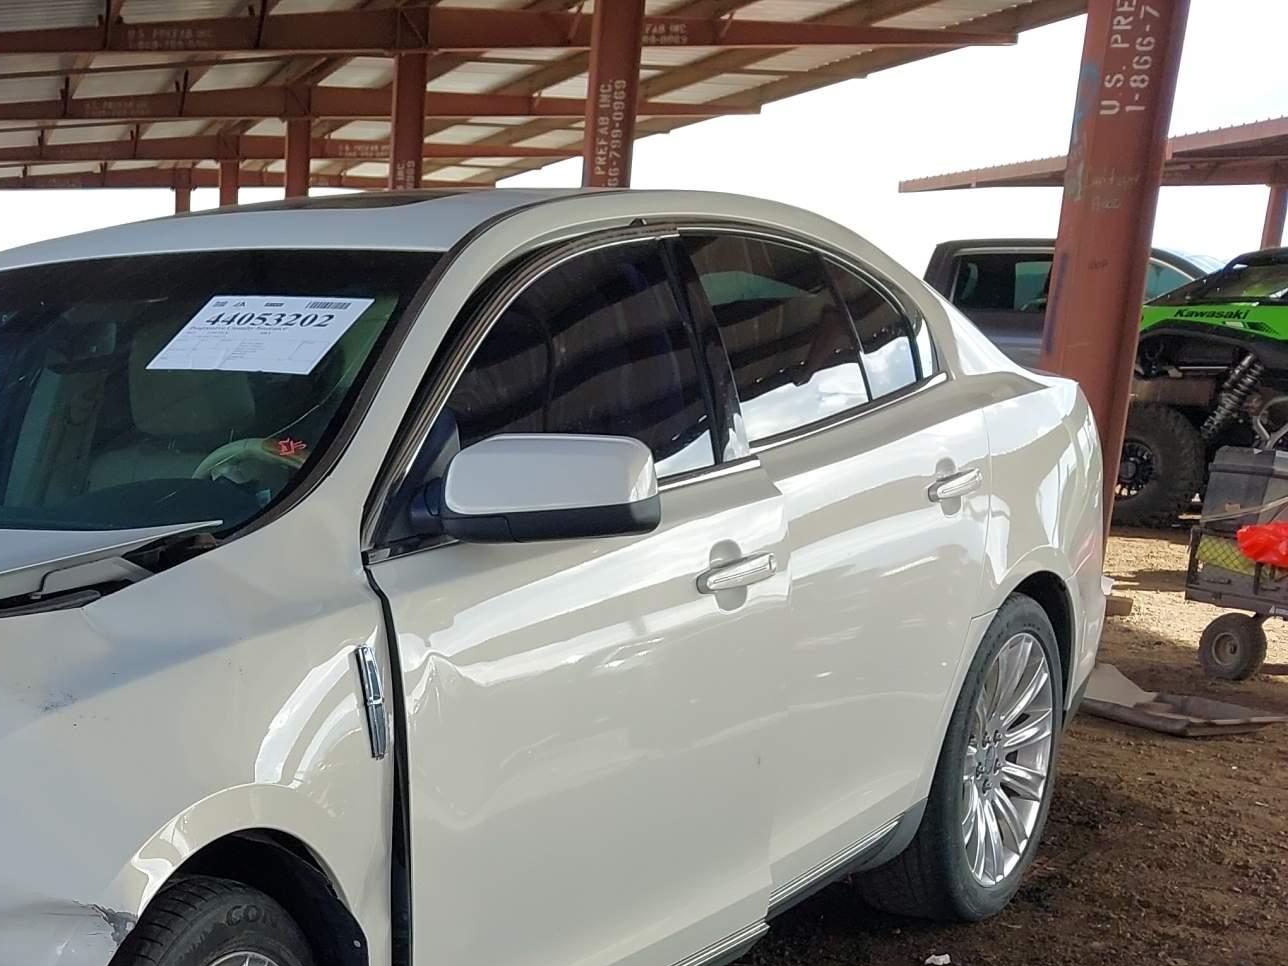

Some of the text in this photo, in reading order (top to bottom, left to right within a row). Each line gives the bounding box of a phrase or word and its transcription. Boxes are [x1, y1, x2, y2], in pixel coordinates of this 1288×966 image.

[594, 116, 611, 176] PREFAB
[205, 311, 336, 328] 44053202
[1173, 308, 1251, 320] Kawasaki
